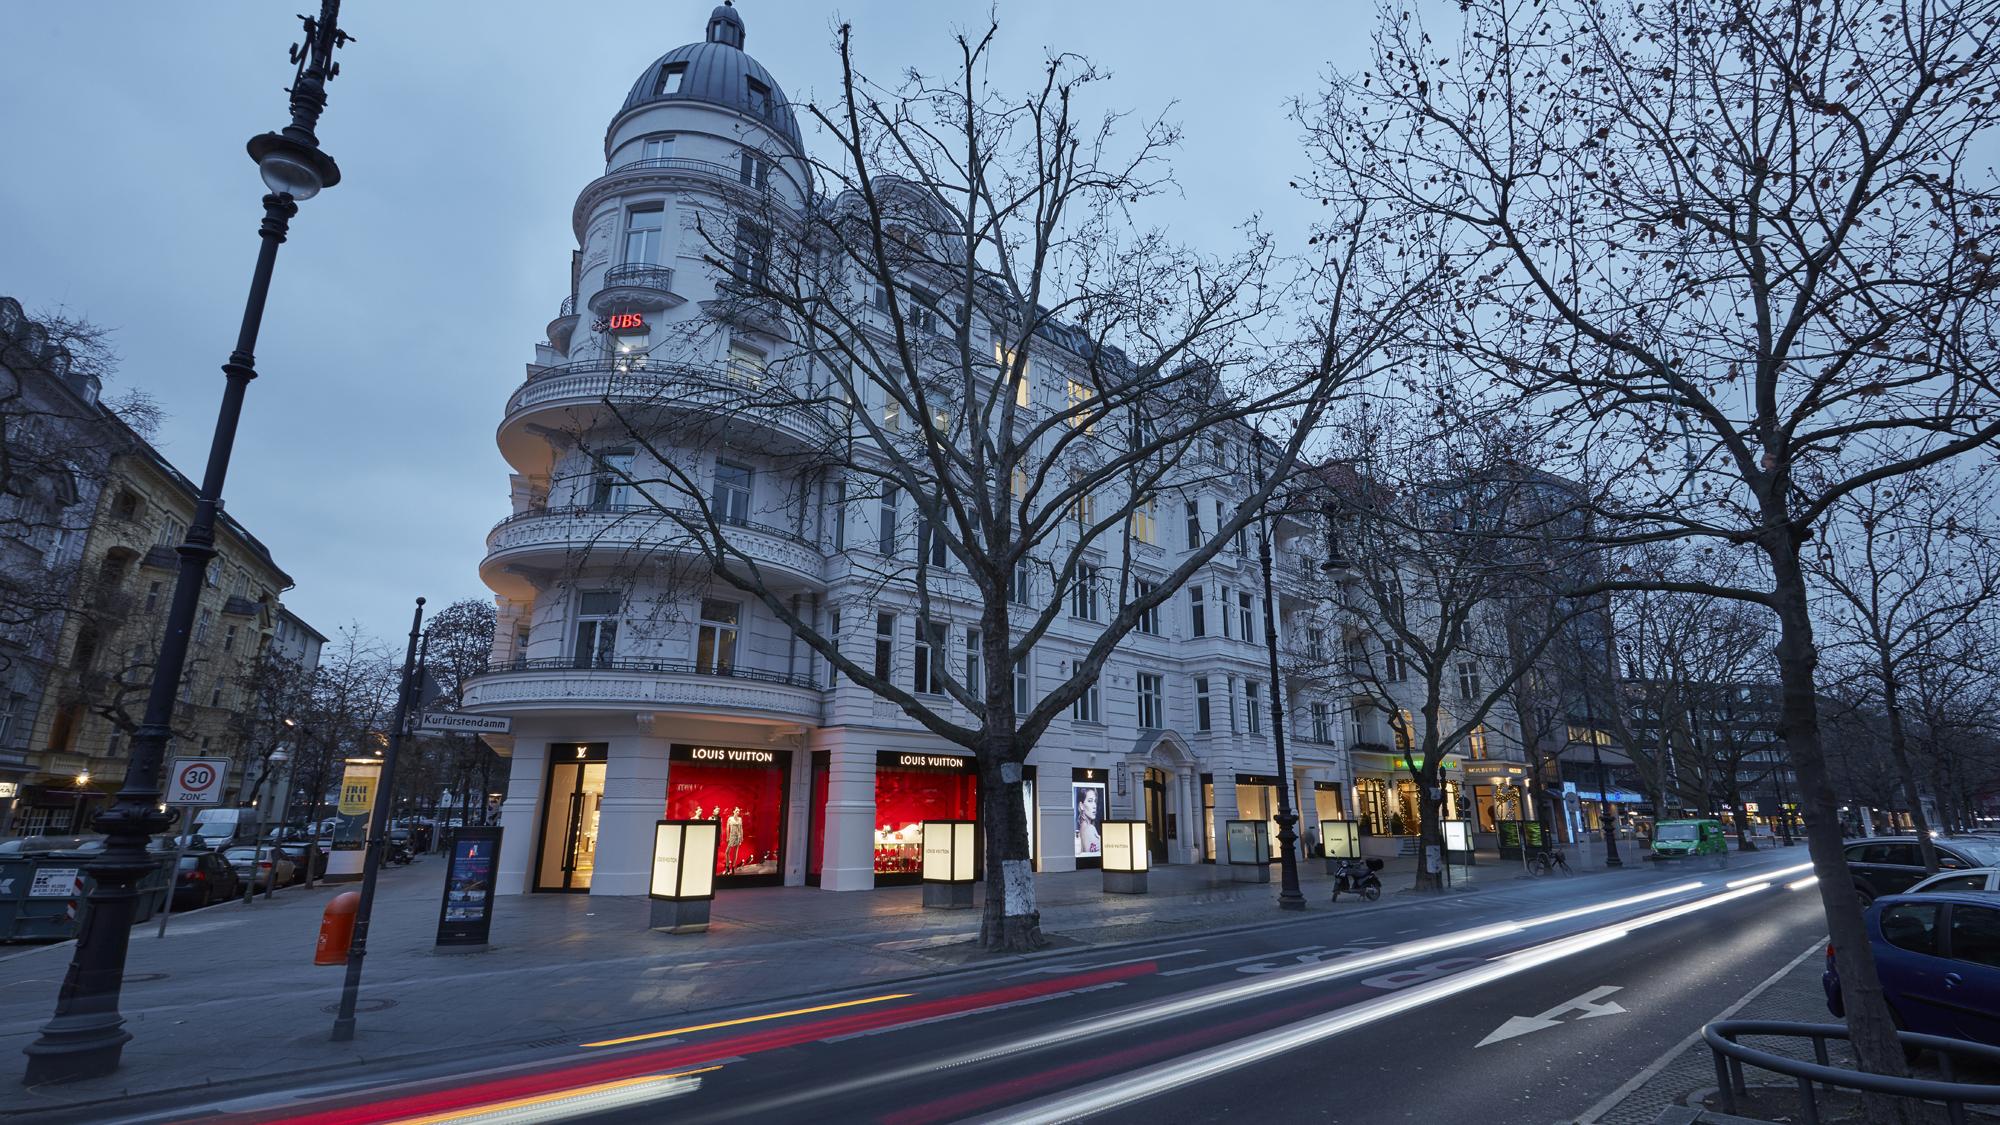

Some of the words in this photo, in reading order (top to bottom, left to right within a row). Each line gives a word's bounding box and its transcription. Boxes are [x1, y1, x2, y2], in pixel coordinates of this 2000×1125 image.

[610, 313, 642, 329] UBS
[424, 714, 506, 729] Kurfürstendamm
[692, 748, 725, 760] LOUIS
[728, 750, 773, 762] VUITTON
[900, 755, 926, 766] LOUIS
[927, 757, 963, 768] VUITTON
[187, 770, 209, 784] 30
[179, 792, 207, 801] ZONE
